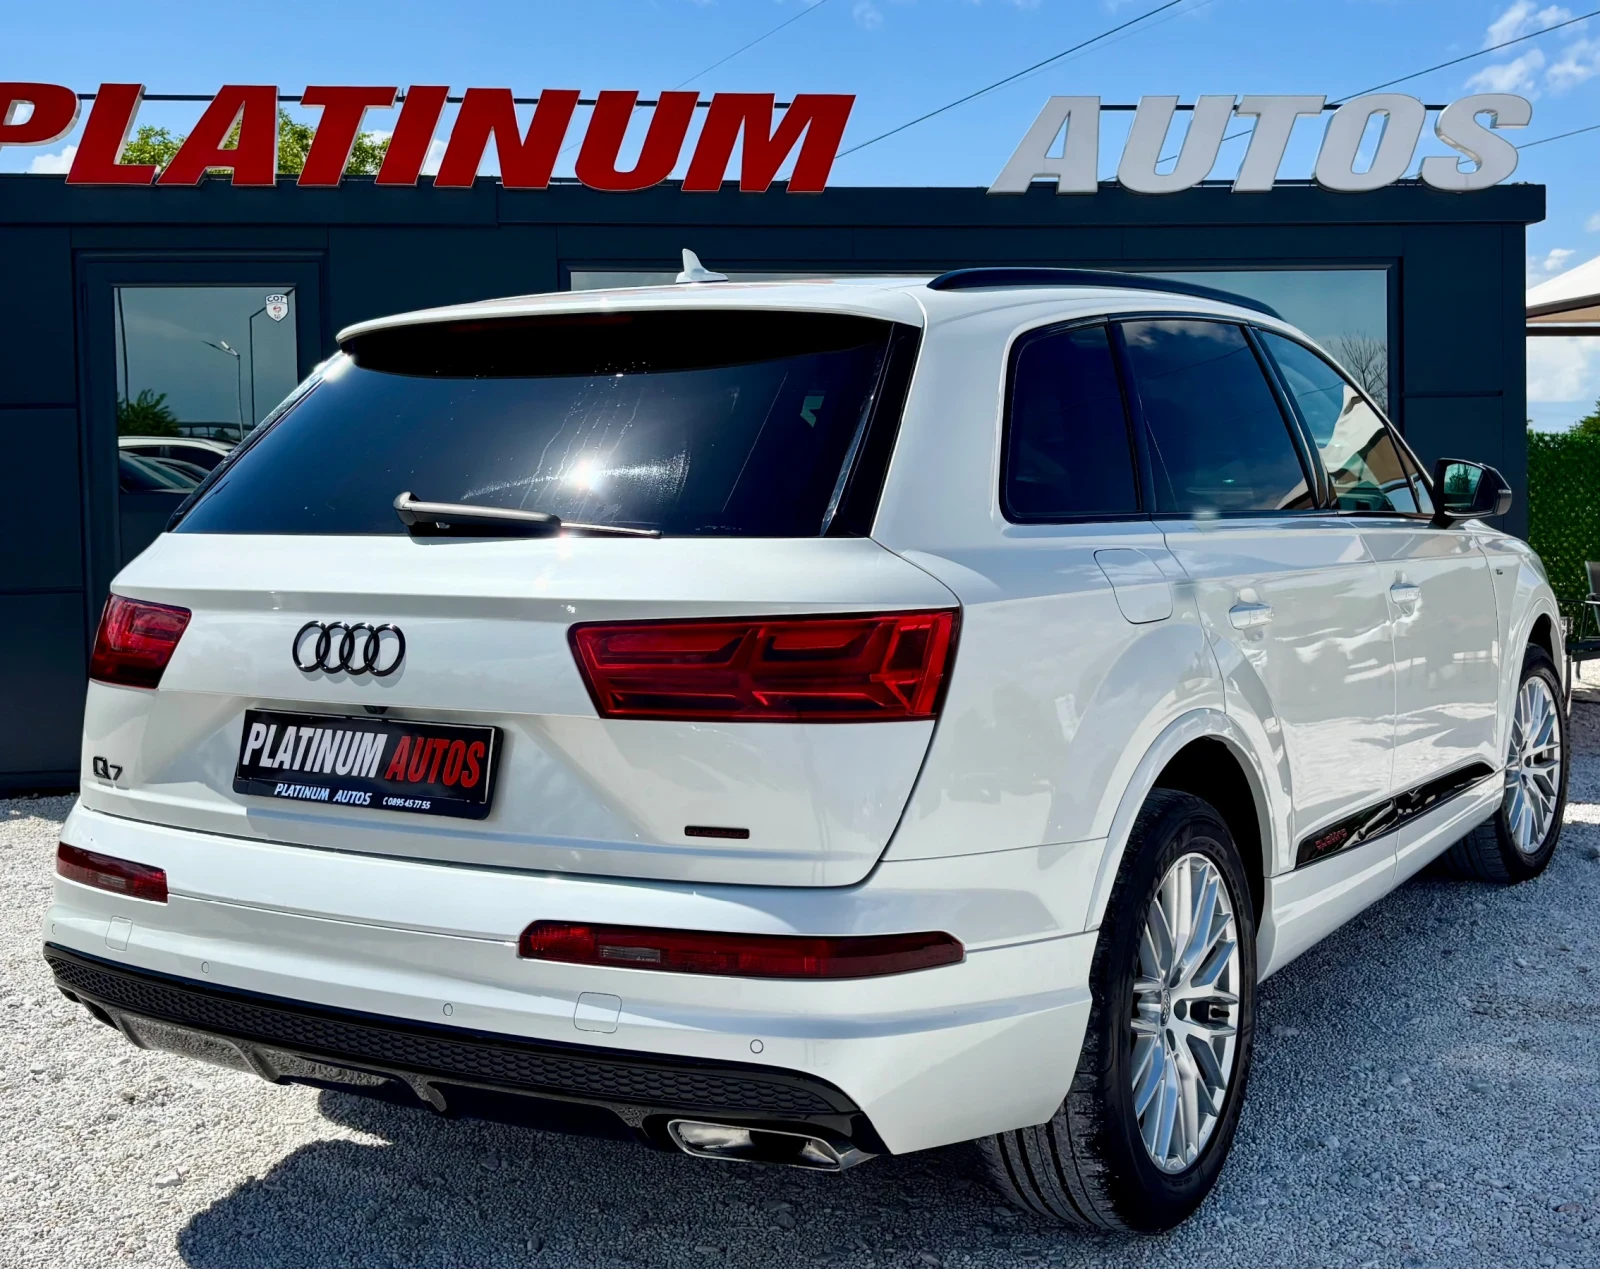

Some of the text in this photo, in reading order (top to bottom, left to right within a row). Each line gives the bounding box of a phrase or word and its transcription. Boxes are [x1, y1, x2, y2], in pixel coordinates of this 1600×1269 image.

[0, 82, 1533, 195] PLATINUM AUTOS
[93, 756, 123, 781] Q7
[242, 723, 485, 787] PLATINUM AUTOS
[274, 783, 373, 805] PLATINUM AUTOS
